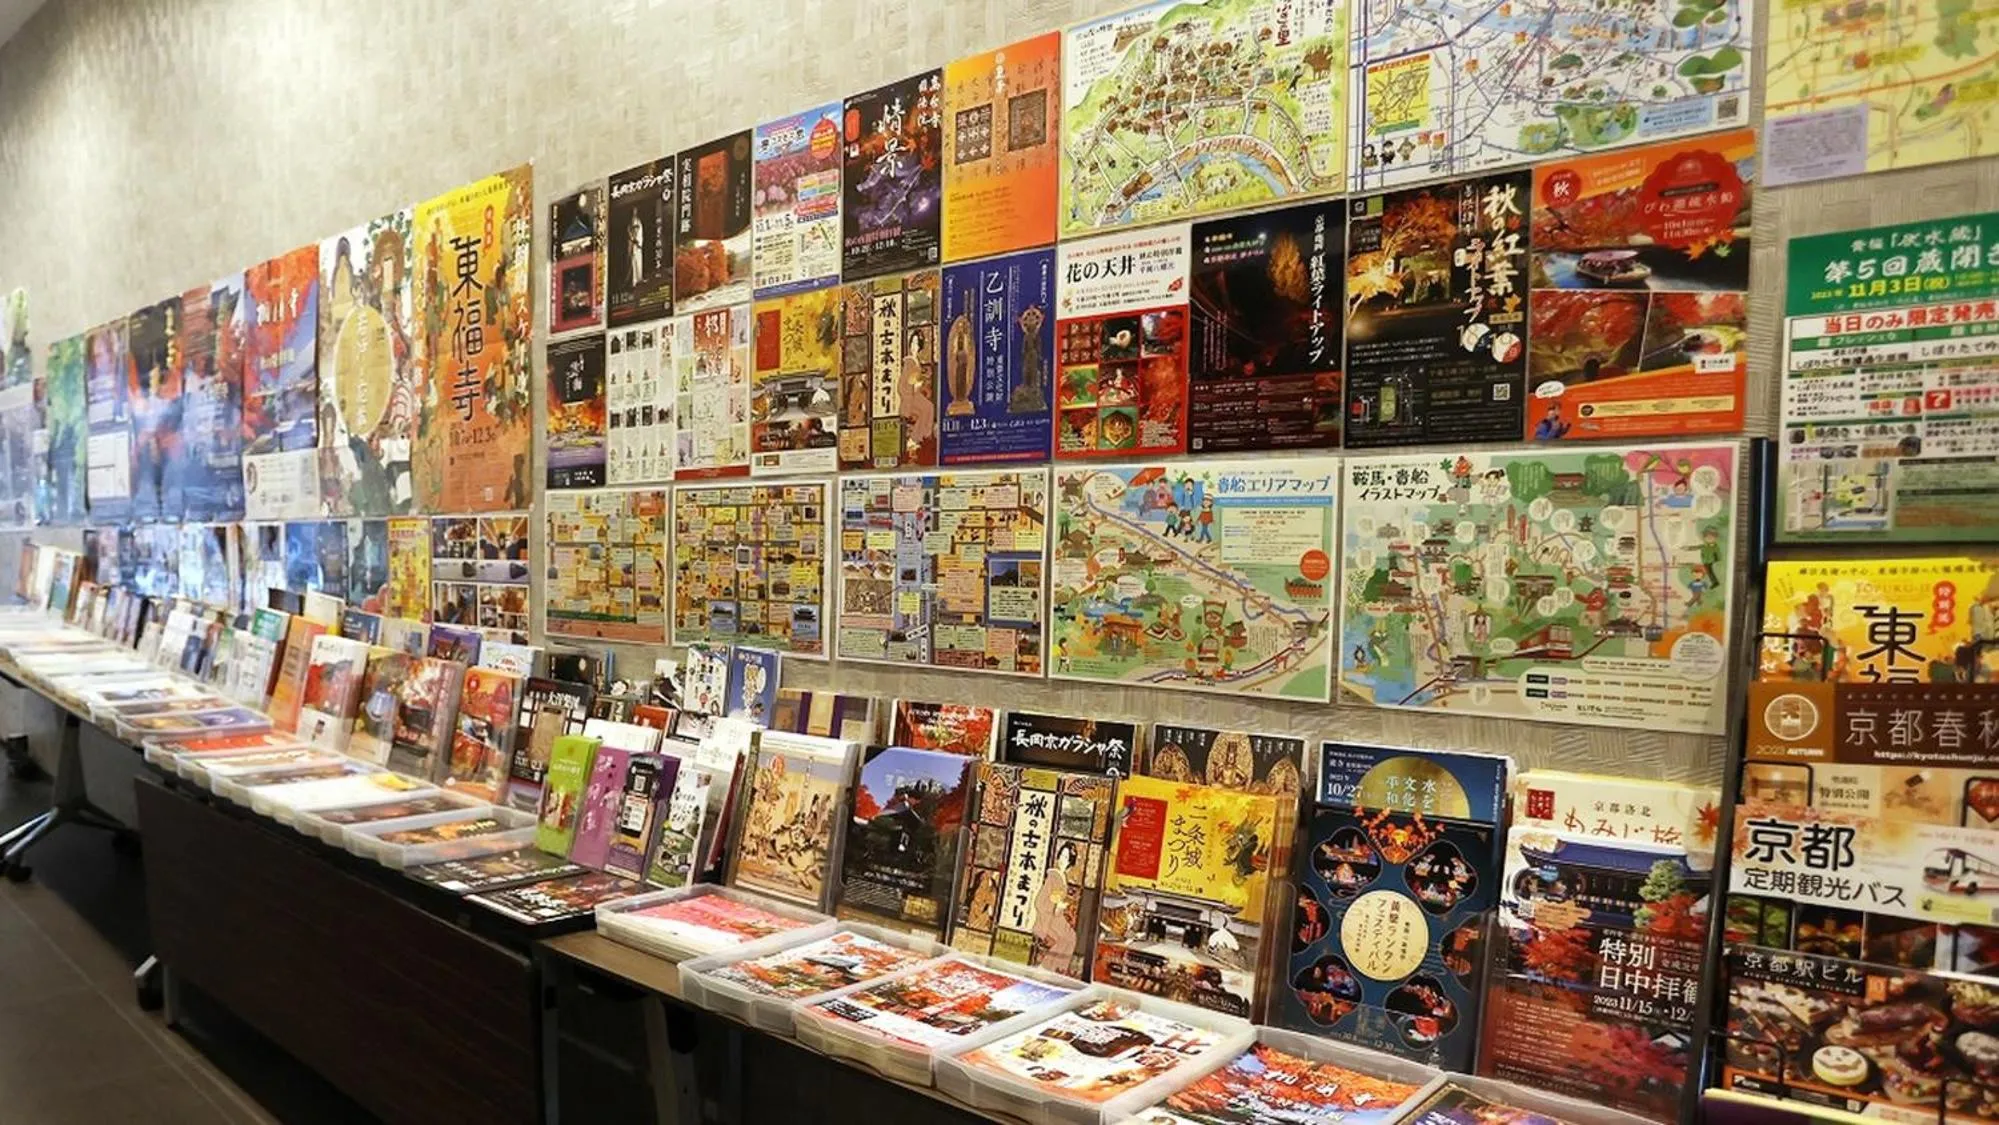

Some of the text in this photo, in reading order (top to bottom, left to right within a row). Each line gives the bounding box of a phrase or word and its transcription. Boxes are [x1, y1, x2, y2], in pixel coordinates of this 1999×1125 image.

[877, 98, 907, 179] 情景
[1552, 180, 1570, 197] 秋
[1067, 255, 1136, 284] 花の天井
[1848, 276, 1950, 298] 11月3日(祝)
[449, 235, 483, 421] 東福寺
[984, 271, 1004, 352] 乙訓寺
[1824, 301, 1997, 334] 当日のみ限定発売
[875, 298, 897, 414] 秋の古本まつり
[1218, 475, 1331, 493] 貴船エリアマップ
[1352, 468, 1429, 486] 鞍馬・貴船
[1360, 485, 1440, 501] イラストマップ
[1011, 728, 1127, 761] 長岡京ガラシャ祭
[1012, 794, 1047, 927] 秋の古本まつり
[1745, 818, 1855, 872] 京都
[1743, 867, 1906, 908] 定期観光バス
[1599, 938, 1656, 970] 特別
[1743, 951, 1864, 984] 京都駅ビル
[1593, 993, 1618, 1007] 2023
[1619, 994, 1653, 1016] 11/15
